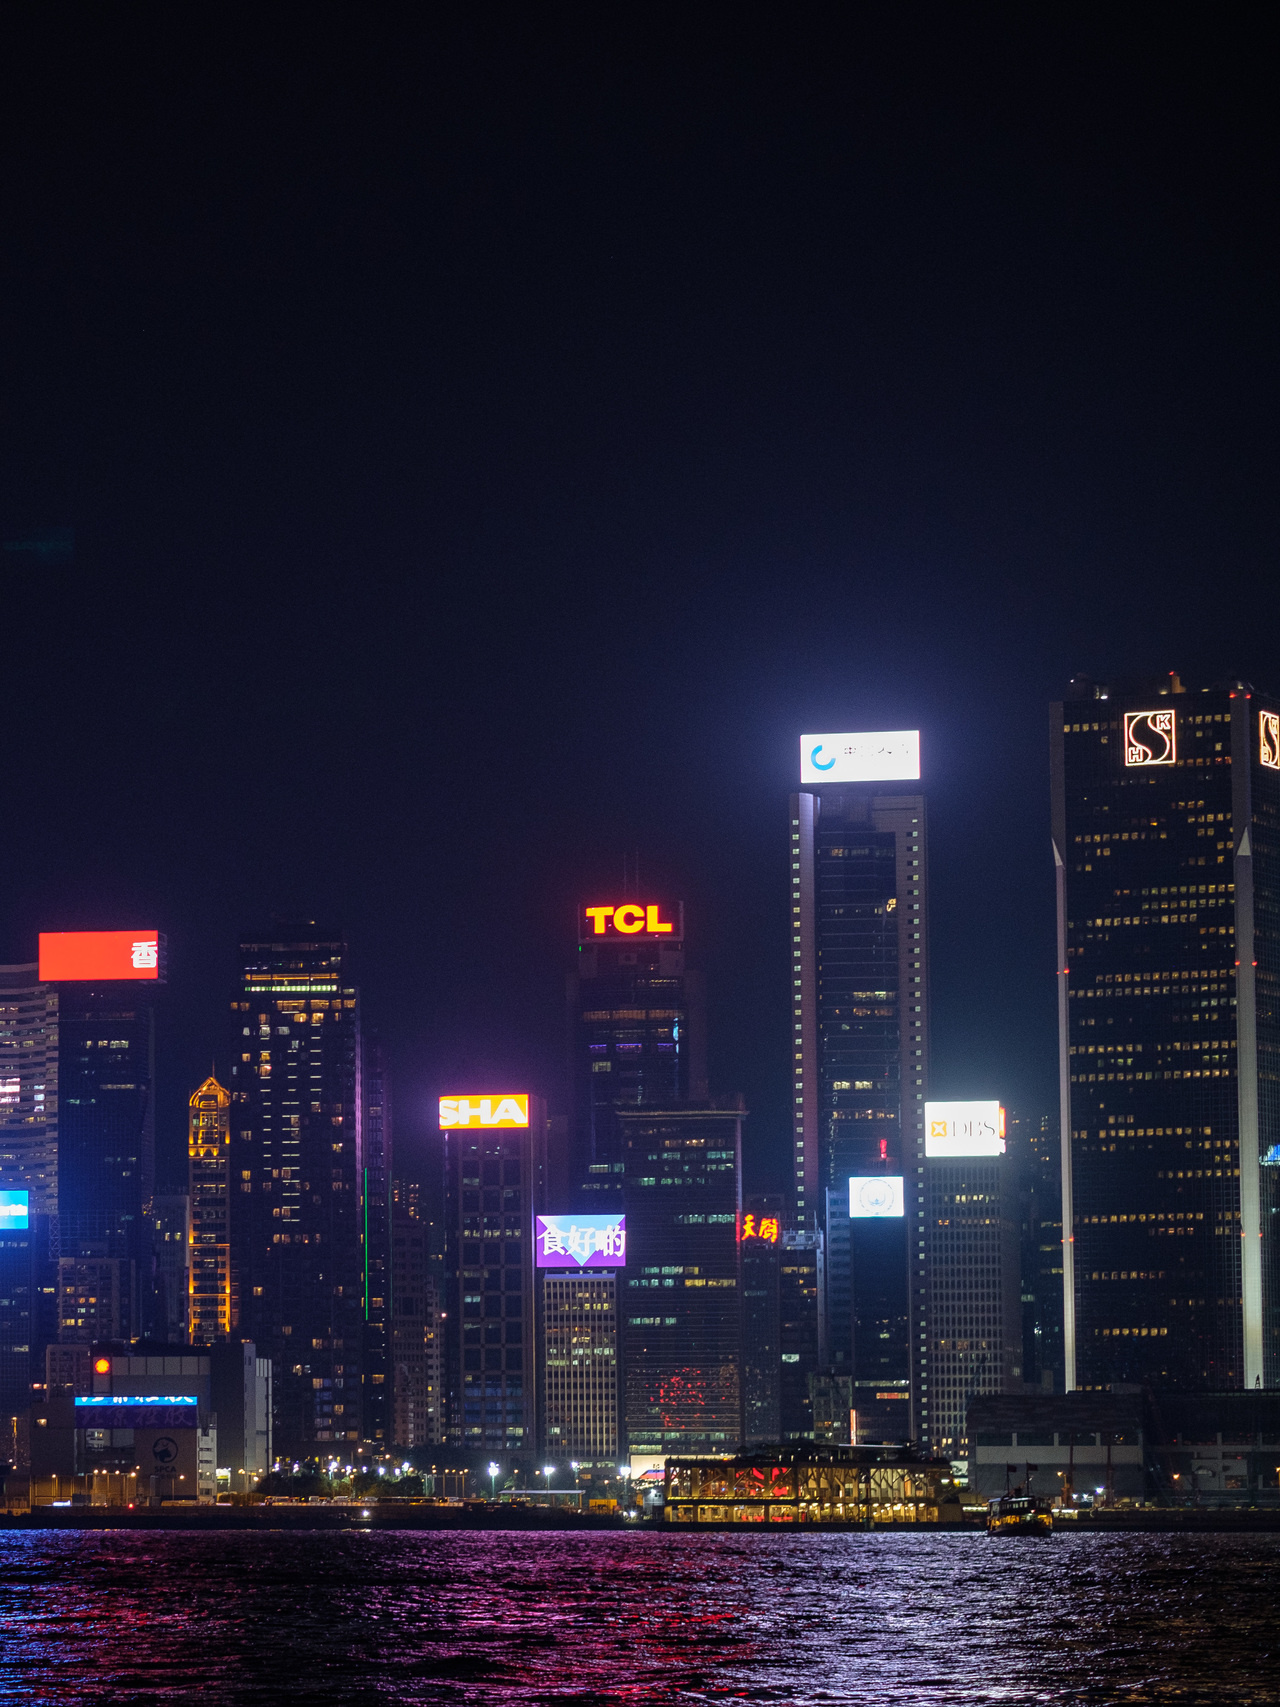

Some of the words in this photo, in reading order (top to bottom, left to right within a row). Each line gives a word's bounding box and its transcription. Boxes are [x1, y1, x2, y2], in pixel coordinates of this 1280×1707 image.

[585, 904, 673, 934] TCL
[130, 940, 158, 969] 香
[952, 1120, 997, 1137] DBS
